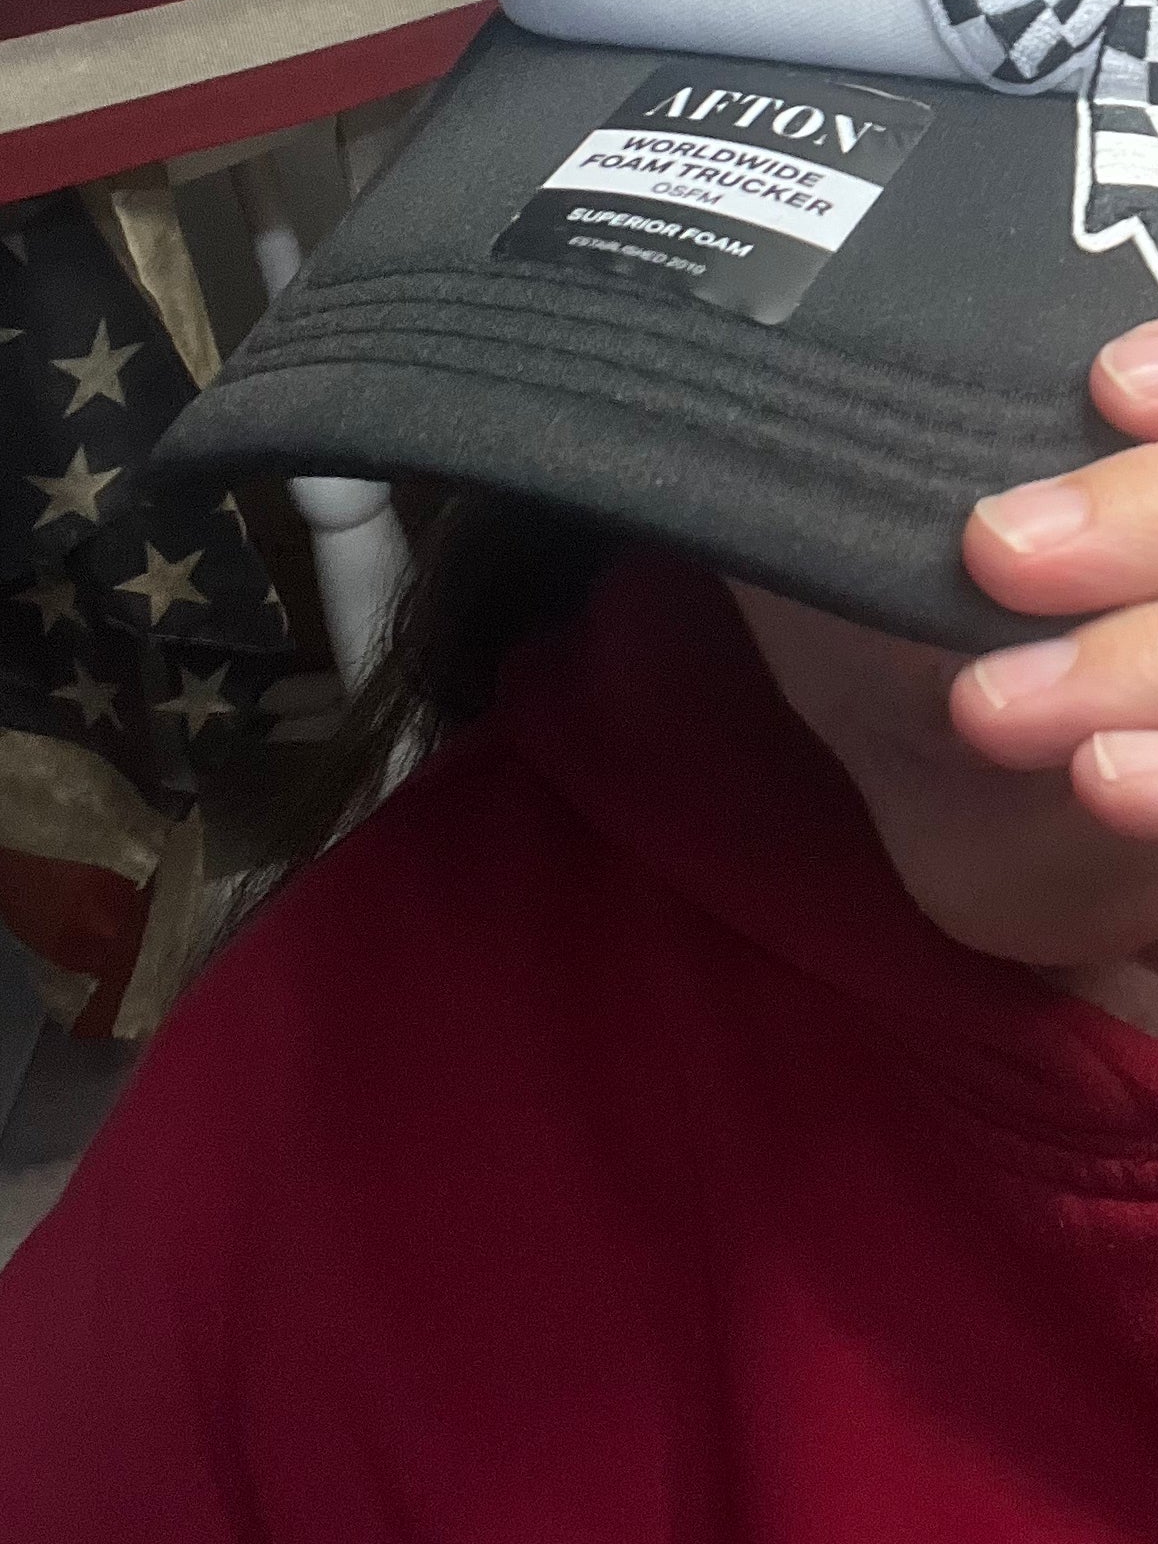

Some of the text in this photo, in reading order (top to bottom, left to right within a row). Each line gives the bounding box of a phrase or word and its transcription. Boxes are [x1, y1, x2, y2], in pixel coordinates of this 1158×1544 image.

[644, 85, 886, 154] AFTON
[579, 153, 834, 218] FOAM TRUCKER
[622, 136, 825, 188] WORLDWIDE
[566, 206, 755, 258] SUPERIOR FOAM
